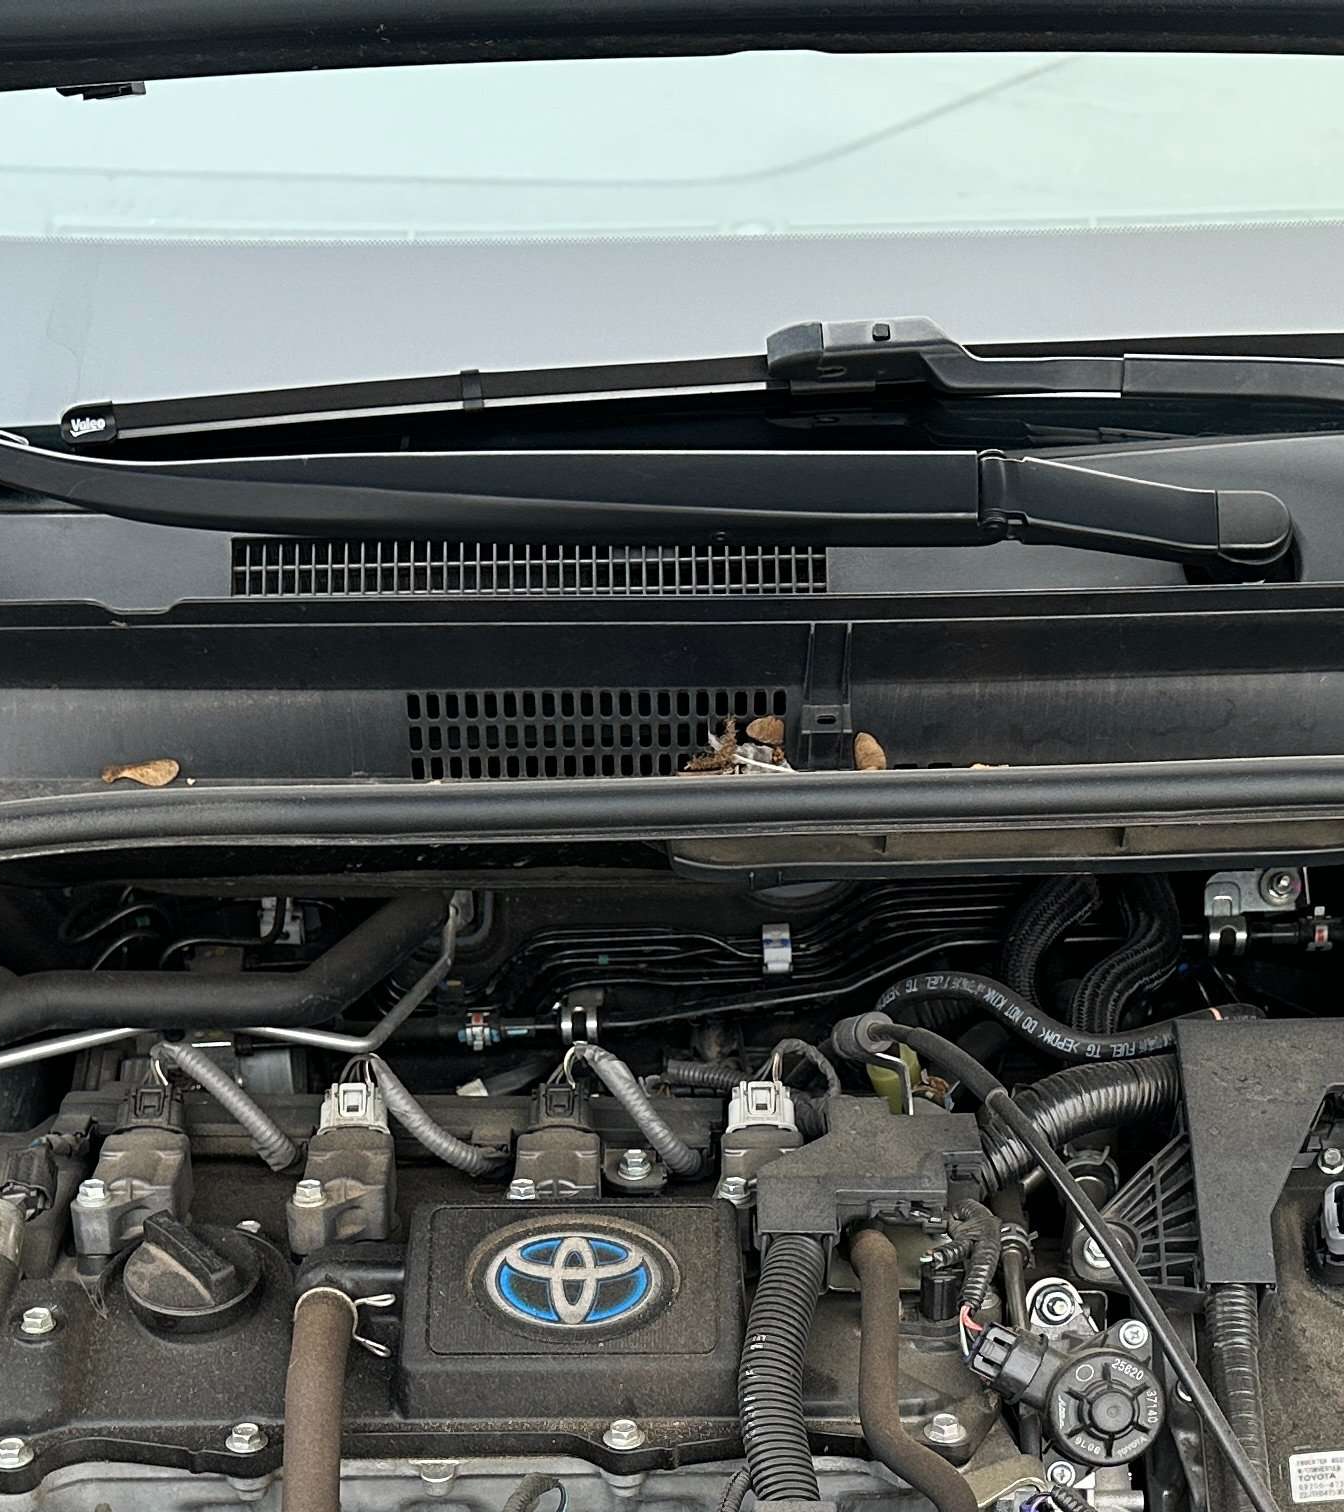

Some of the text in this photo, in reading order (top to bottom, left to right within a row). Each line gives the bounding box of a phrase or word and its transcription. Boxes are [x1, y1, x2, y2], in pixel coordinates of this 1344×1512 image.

[70, 417, 106, 434] Valeo
[983, 987, 1008, 1008] KINK
[1004, 1004, 1025, 1023] NOT
[1021, 1016, 1038, 1034] DO
[1086, 1043, 1102, 1058] TG
[1110, 1041, 1136, 1058] FUEL
[1145, 1389, 1158, 1423] 37140
[1117, 1436, 1148, 1456] TOYOTA
[1298, 1472, 1336, 1482] TOYOTA
